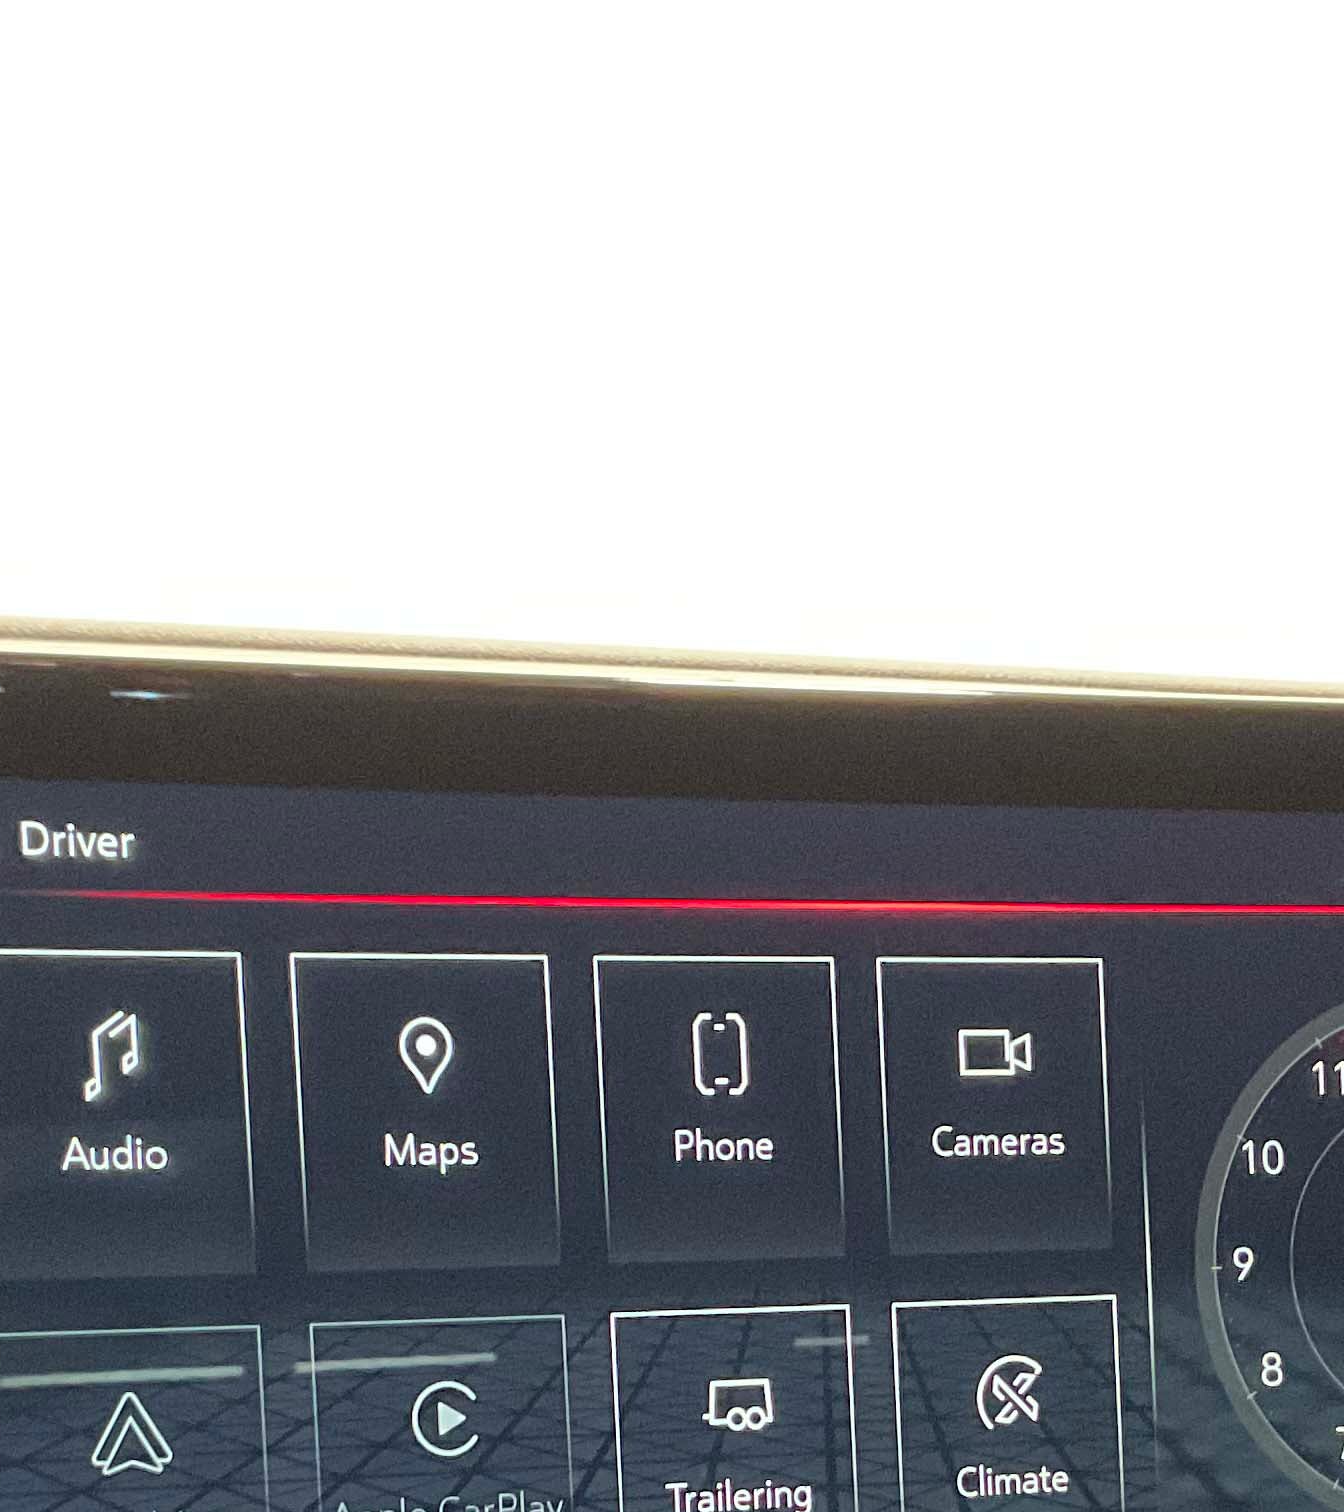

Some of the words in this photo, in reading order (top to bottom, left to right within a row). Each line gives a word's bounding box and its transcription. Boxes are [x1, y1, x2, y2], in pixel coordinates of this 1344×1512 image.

[19, 820, 135, 860] Driver
[62, 1136, 169, 1172] Audio
[383, 1133, 479, 1177] Maps
[674, 1129, 774, 1161] Phone
[932, 1126, 1065, 1157] Cameras
[1241, 1140, 1284, 1175] 10
[1232, 1247, 1254, 1282] 9
[1261, 1353, 1284, 1387] 8
[956, 1465, 1069, 1499] Climate
